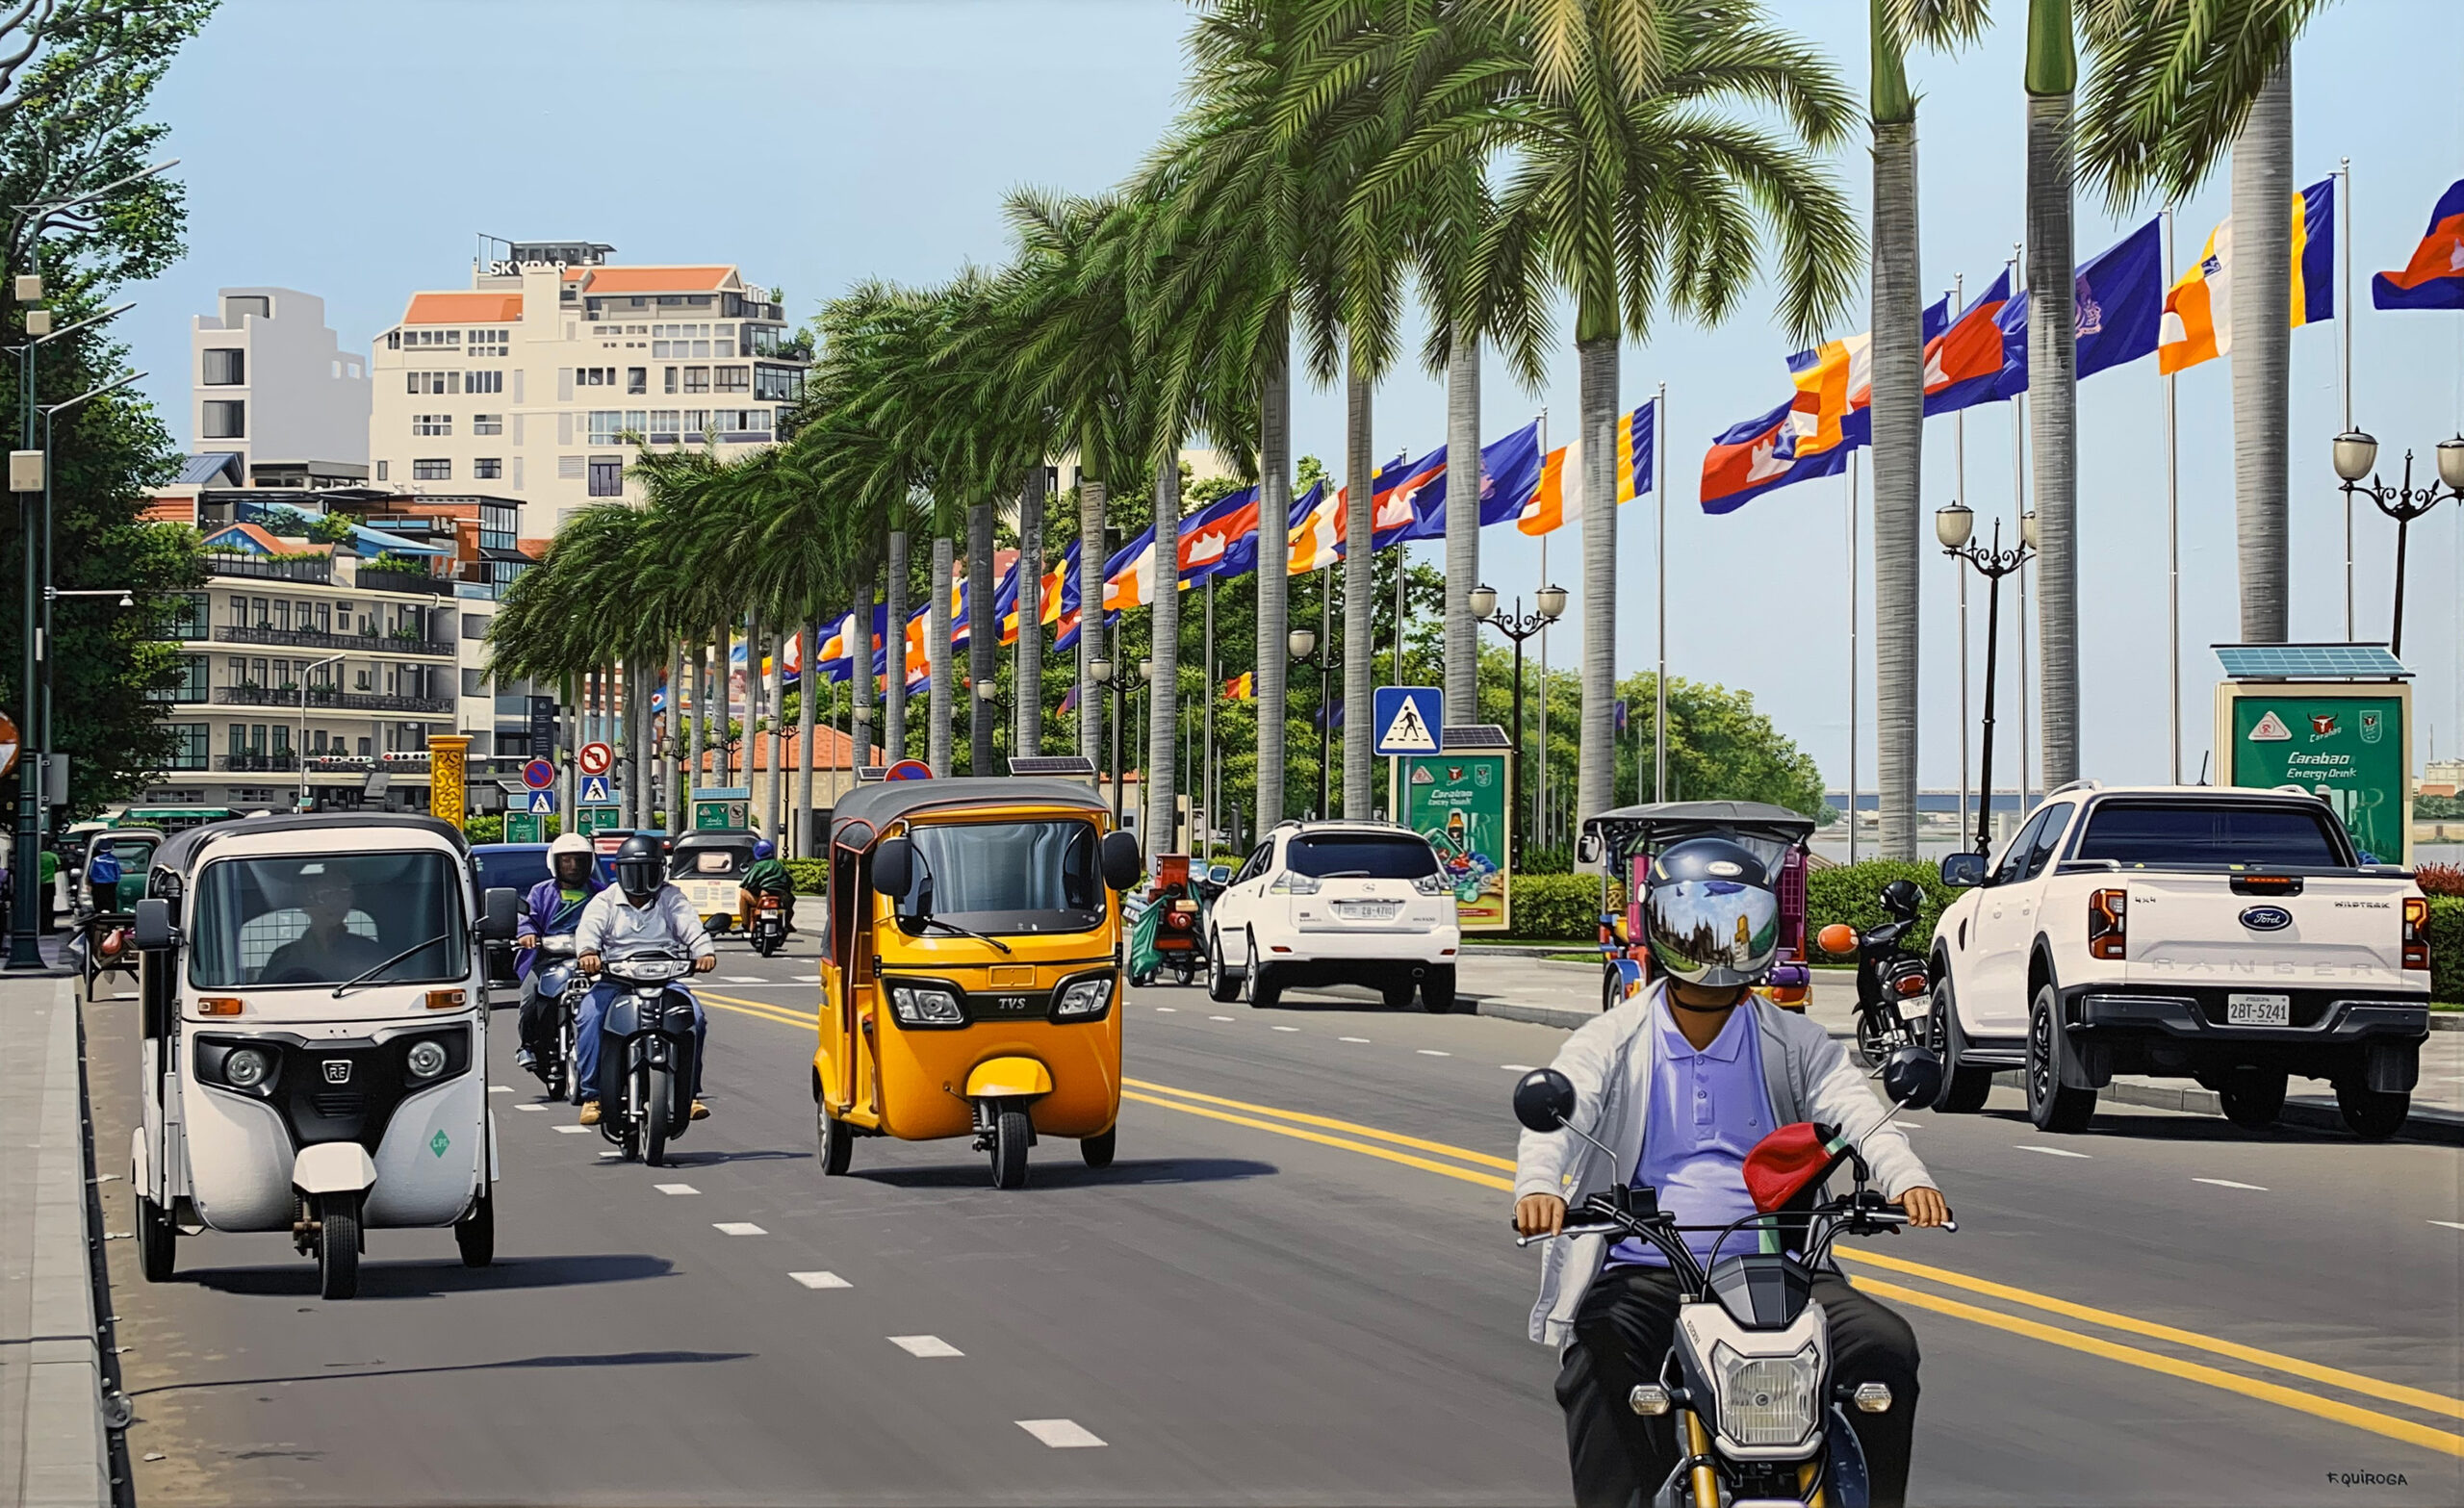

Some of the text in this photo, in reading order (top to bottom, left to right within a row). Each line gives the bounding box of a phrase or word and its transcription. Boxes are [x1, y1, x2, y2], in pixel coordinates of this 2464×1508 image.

[2287, 752, 2350, 765] Carabao
[2286, 767, 2357, 781] Energy Drink
[2253, 912, 2281, 924] Ford
[2152, 958, 2374, 978] RANGER
[998, 997, 1026, 1010] TVS
[2230, 1003, 2287, 1020] 2BT-5241
[329, 1066, 346, 1079] RE
